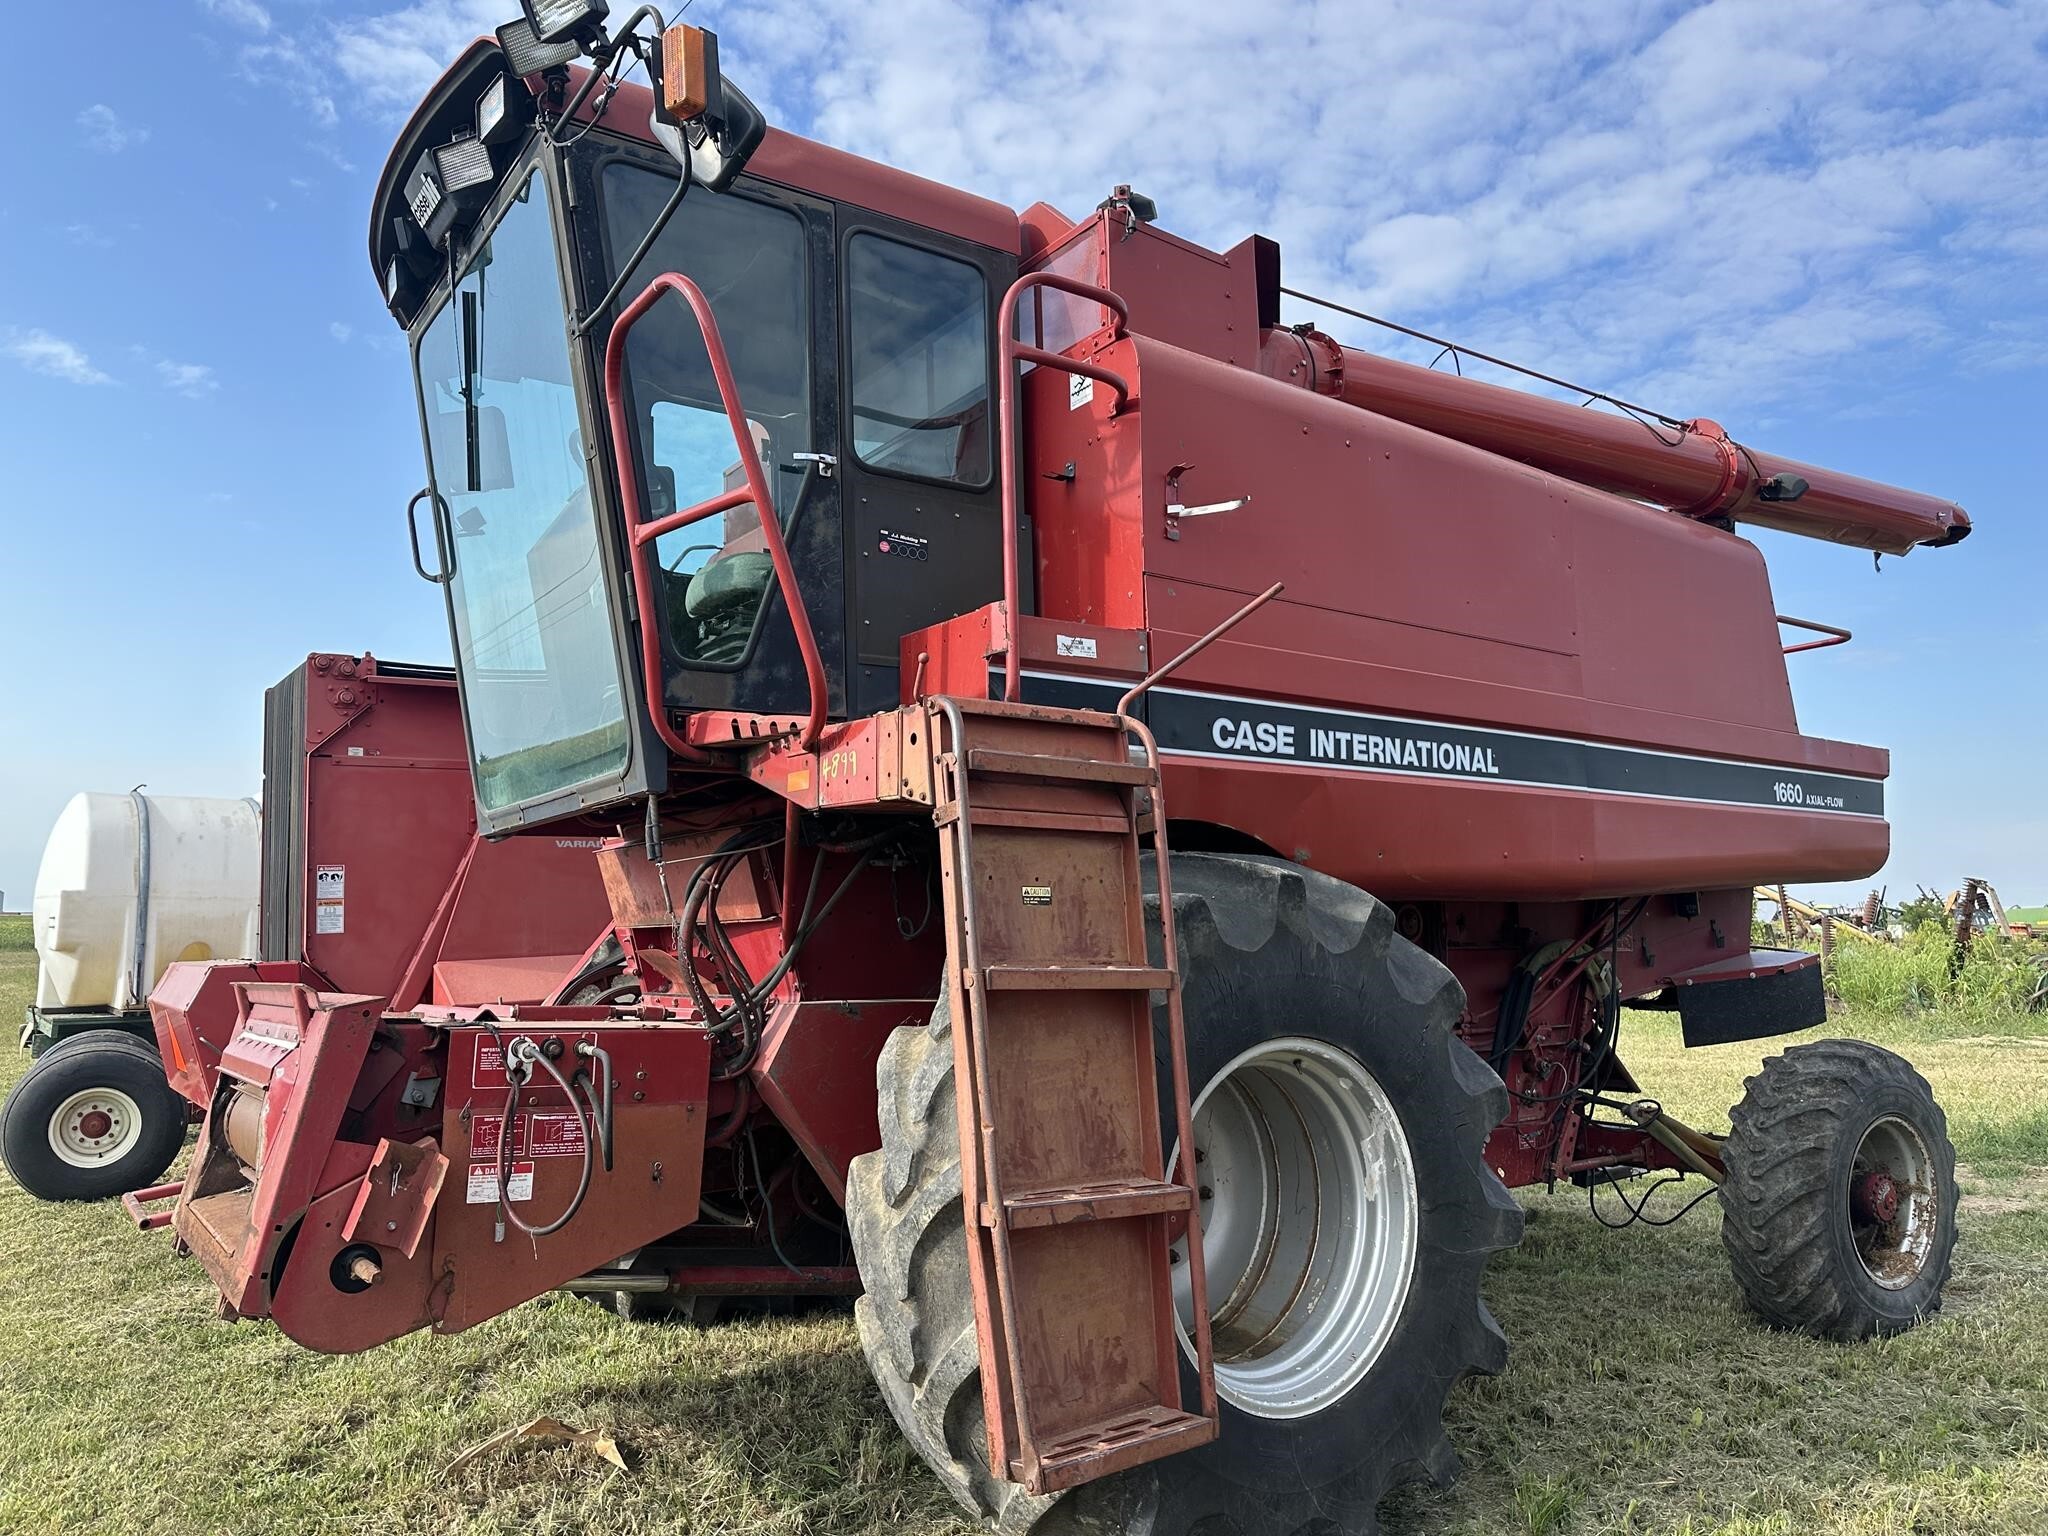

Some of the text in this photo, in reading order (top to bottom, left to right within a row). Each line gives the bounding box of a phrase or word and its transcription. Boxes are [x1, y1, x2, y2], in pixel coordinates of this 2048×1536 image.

[1211, 717, 1499, 774] CASE INTERNATIONAL
[822, 750, 857, 781] 4899
[1773, 782, 1844, 808] 1660 AXIAL-FLOW
[484, 1166, 515, 1175] DAR
